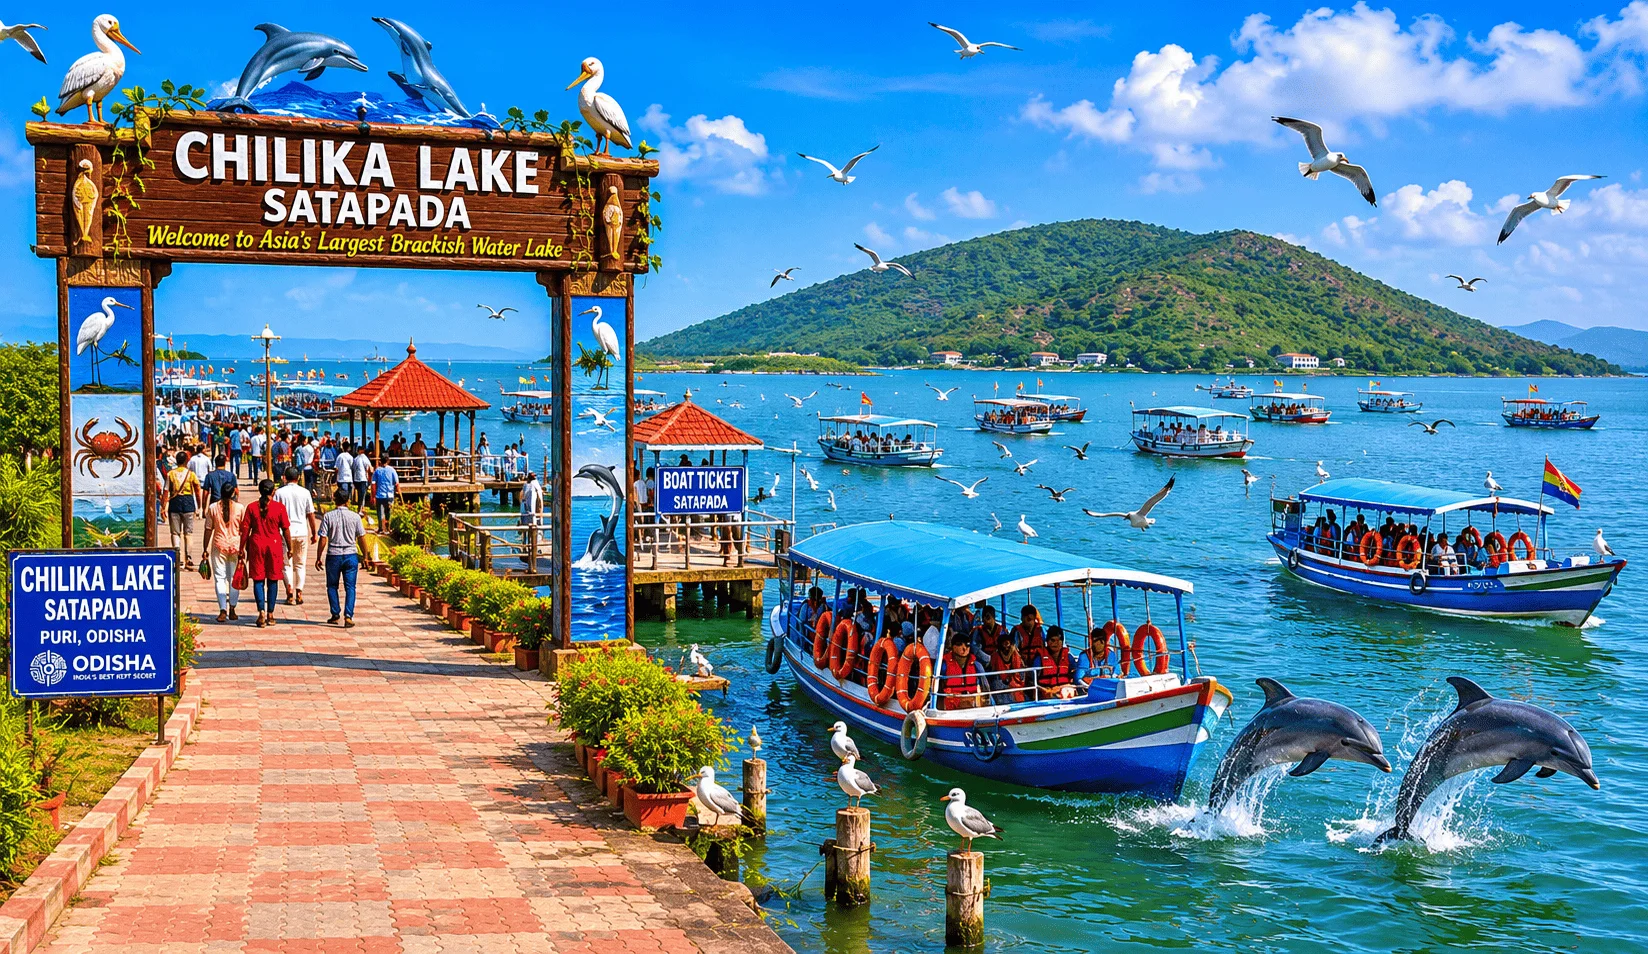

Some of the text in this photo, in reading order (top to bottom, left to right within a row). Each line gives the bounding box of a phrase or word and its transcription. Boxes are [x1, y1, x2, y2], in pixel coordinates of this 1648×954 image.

[175, 131, 539, 194] CHILIKA LAKE
[264, 188, 472, 229] SATAPADA
[147, 225, 563, 258] Welcome to Asia's Largest Brackish Water Lake
[663, 471, 739, 489] BOAT TICKET
[673, 494, 728, 509] SATAPADA
[20, 565, 165, 592] CHILIKA LAKE
[44, 598, 141, 621] SATAPADA
[40, 629, 146, 646] PURI, ODISHA
[72, 654, 156, 672] ODISHA
